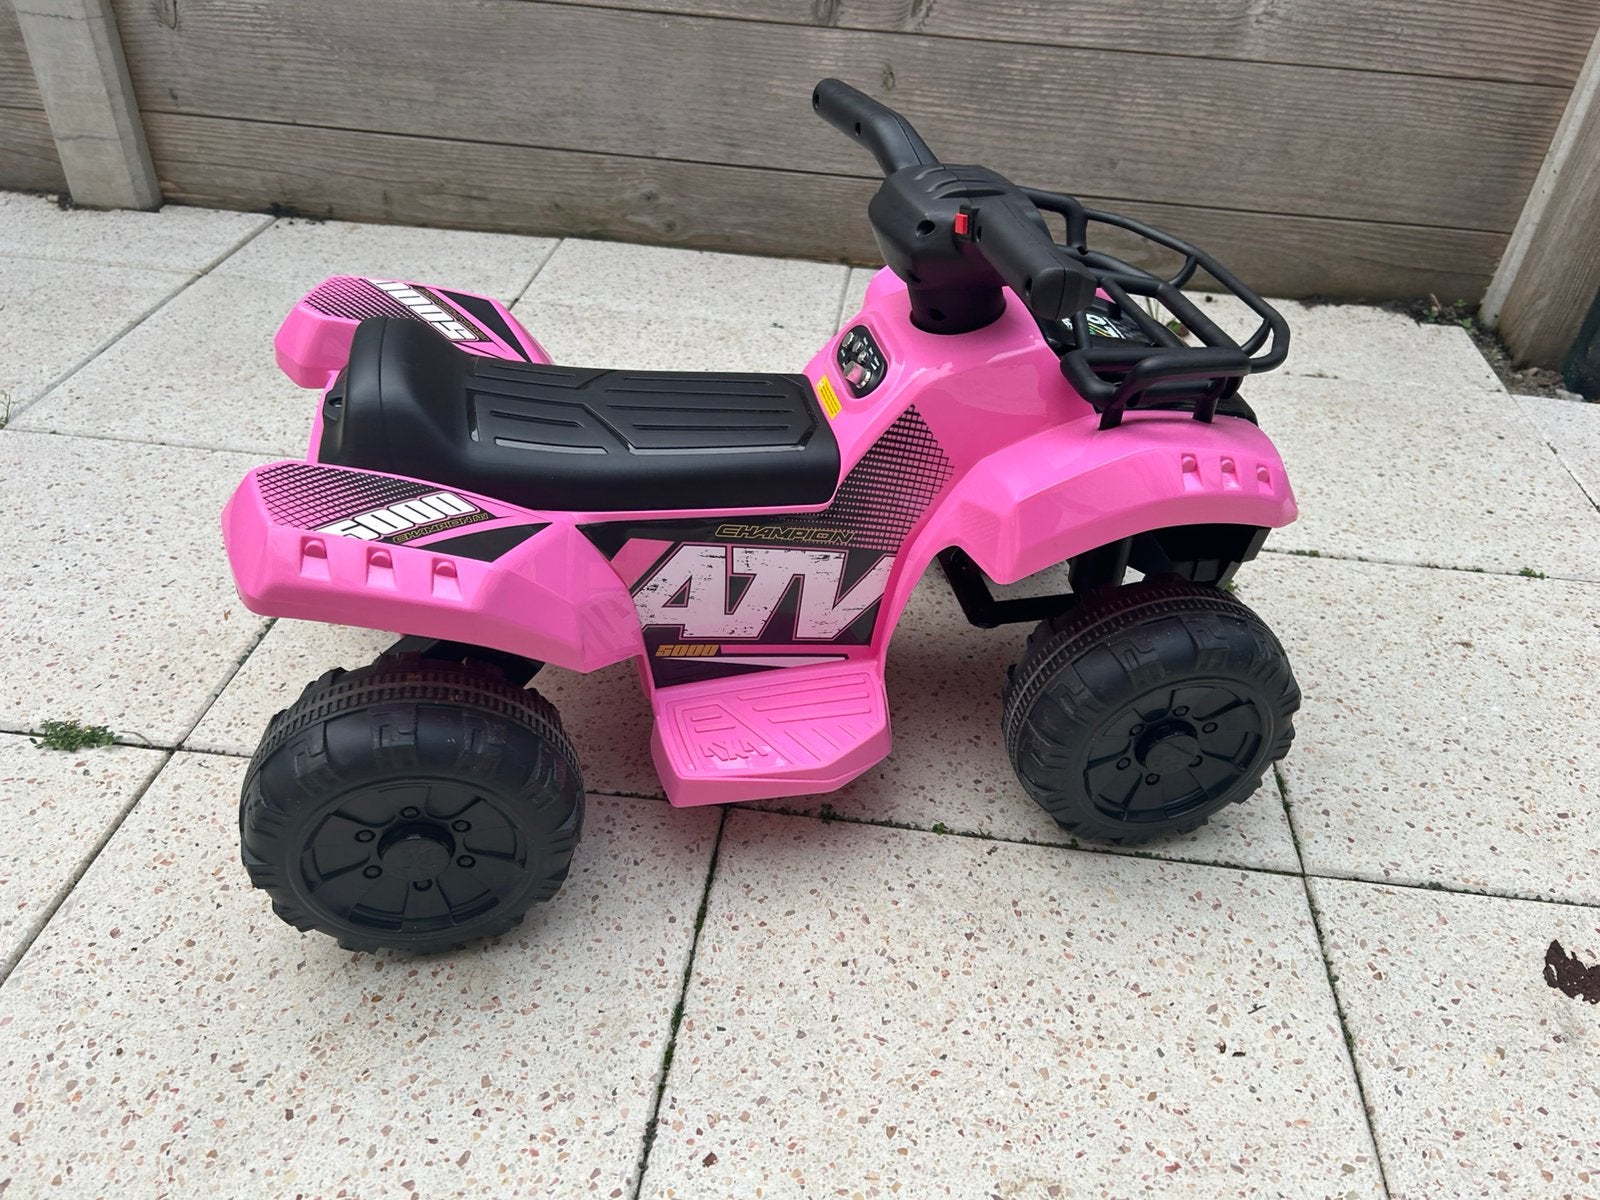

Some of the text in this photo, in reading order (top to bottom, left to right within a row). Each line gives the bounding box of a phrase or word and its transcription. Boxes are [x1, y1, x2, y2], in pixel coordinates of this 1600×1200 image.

[715, 523, 856, 543] CHAMPION
[632, 545, 897, 639] ATV
[655, 644, 720, 657] 5000
